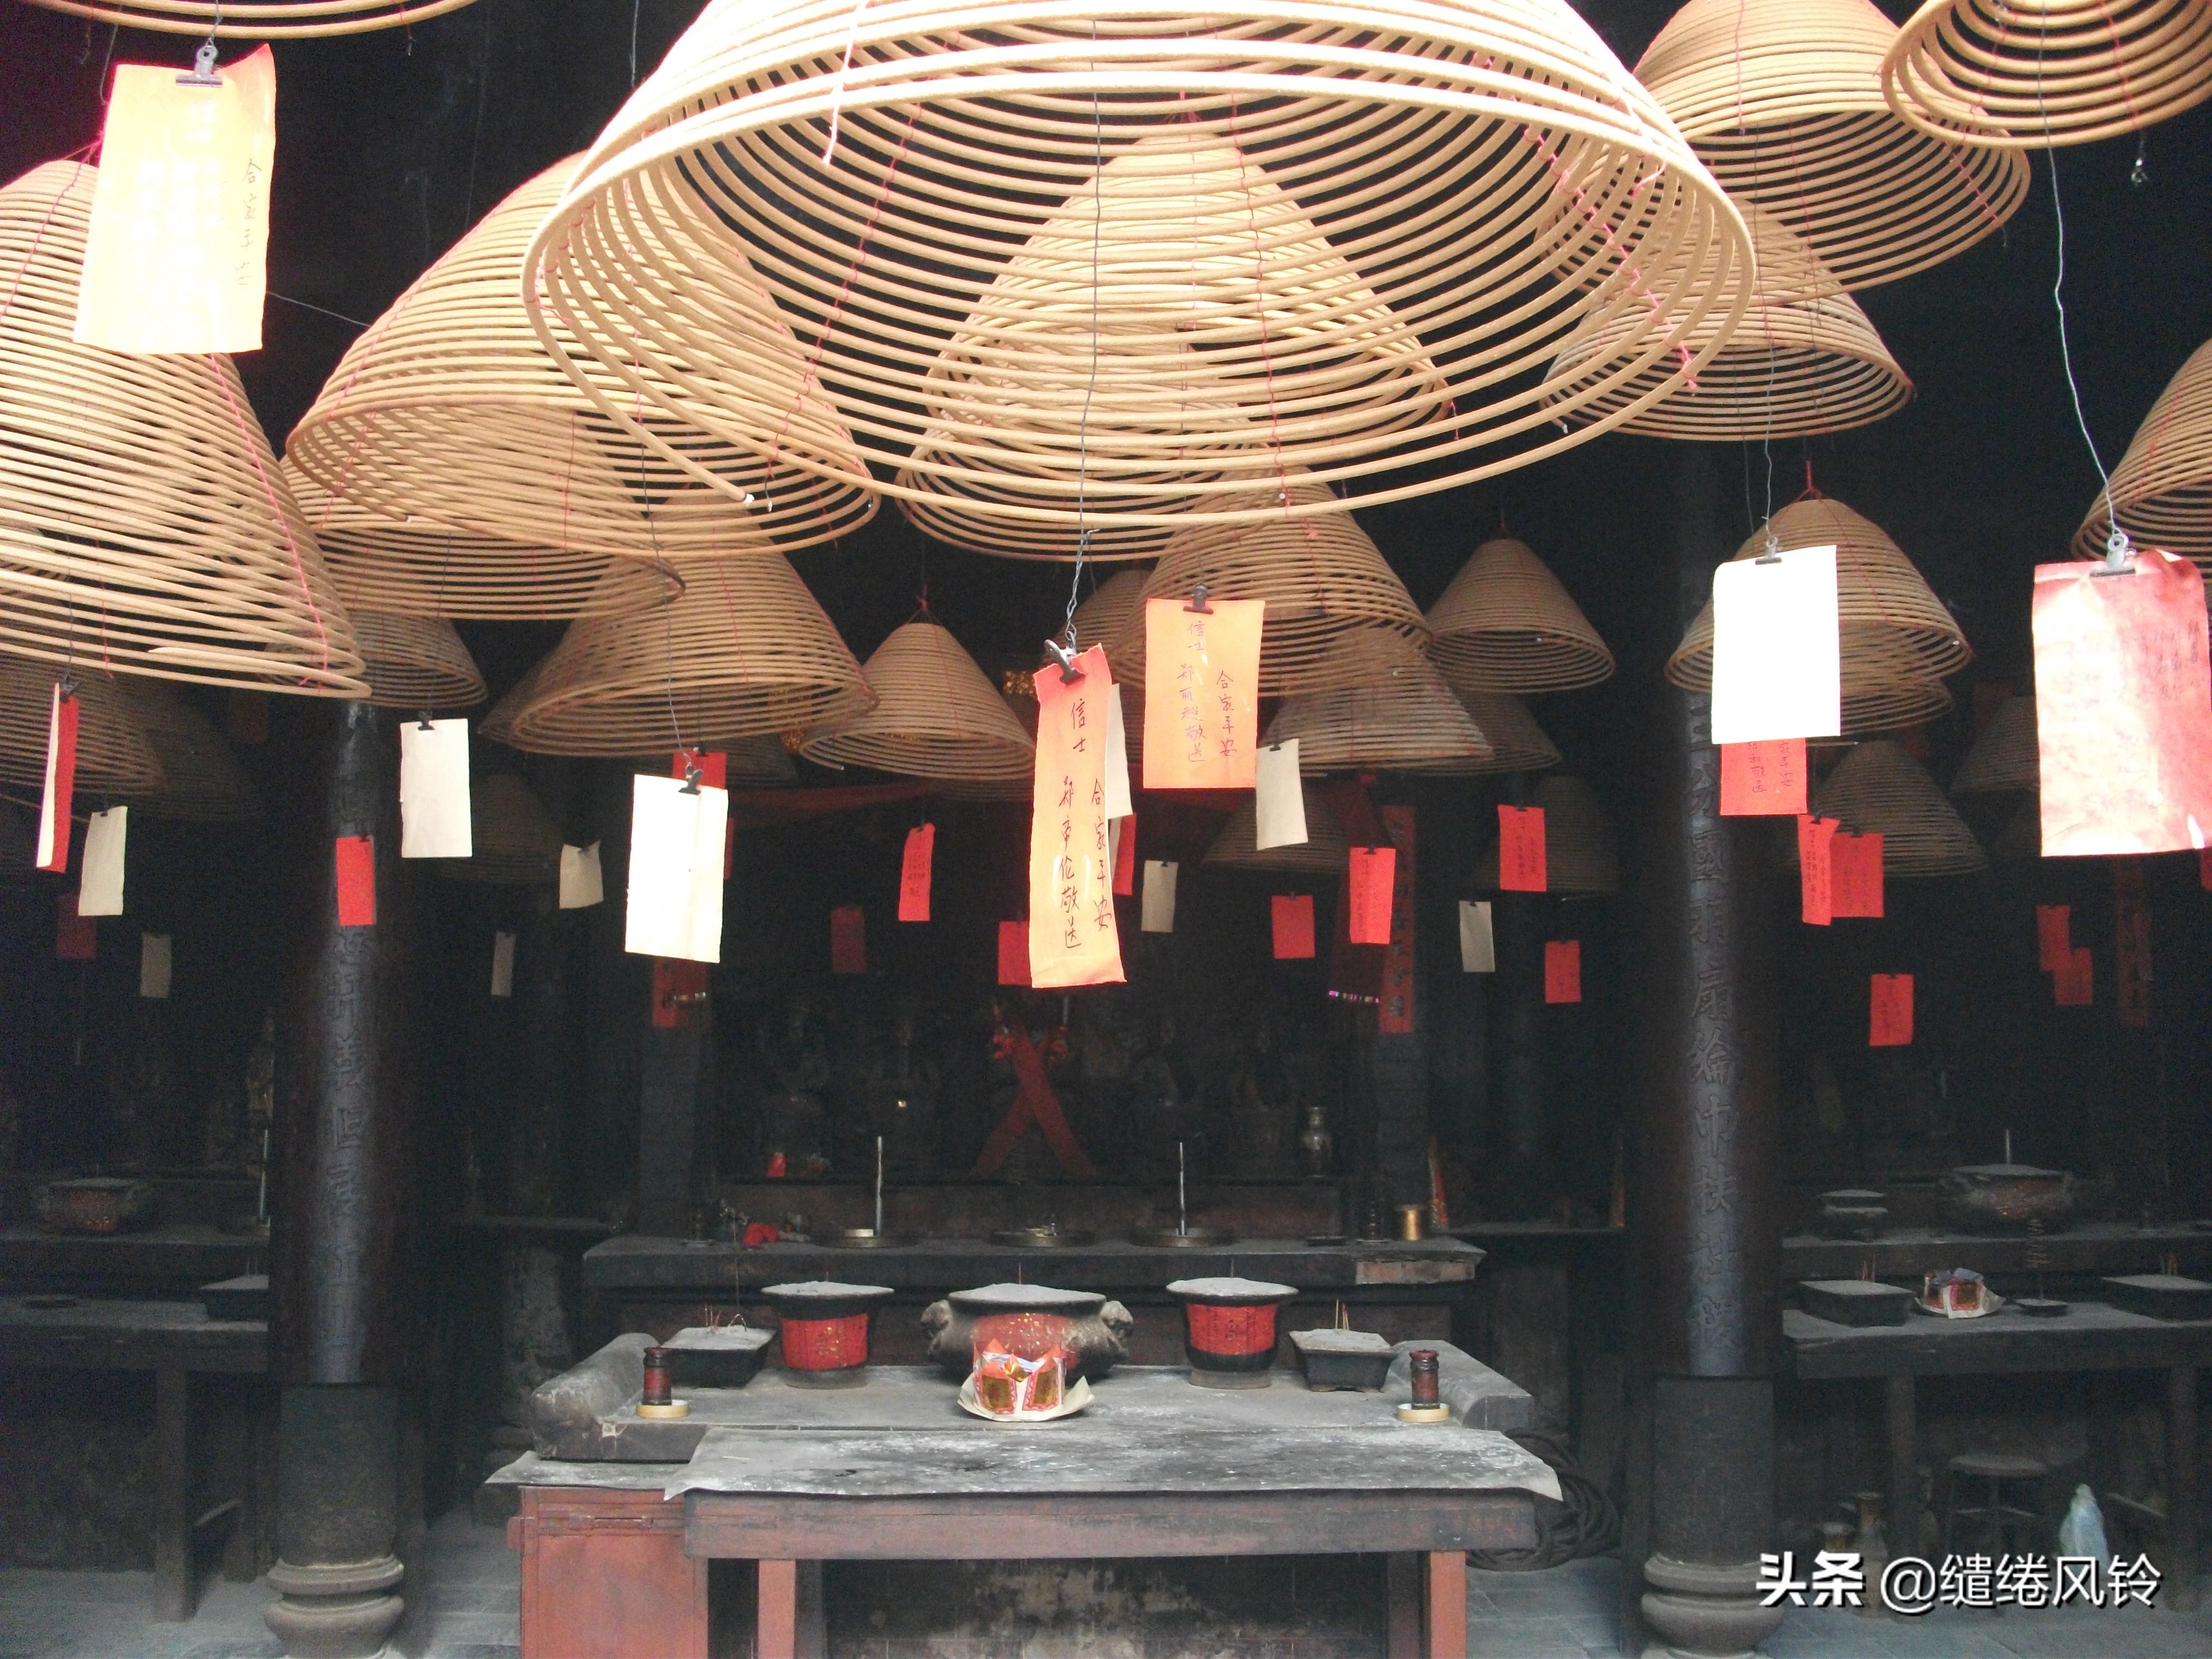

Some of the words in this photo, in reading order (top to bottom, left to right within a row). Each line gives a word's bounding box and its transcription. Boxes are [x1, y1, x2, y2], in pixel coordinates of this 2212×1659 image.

[1070, 698, 1086, 753] 信士
[1216, 670, 1238, 757] 合家平安
[1091, 778, 1112, 932] 合家平安
